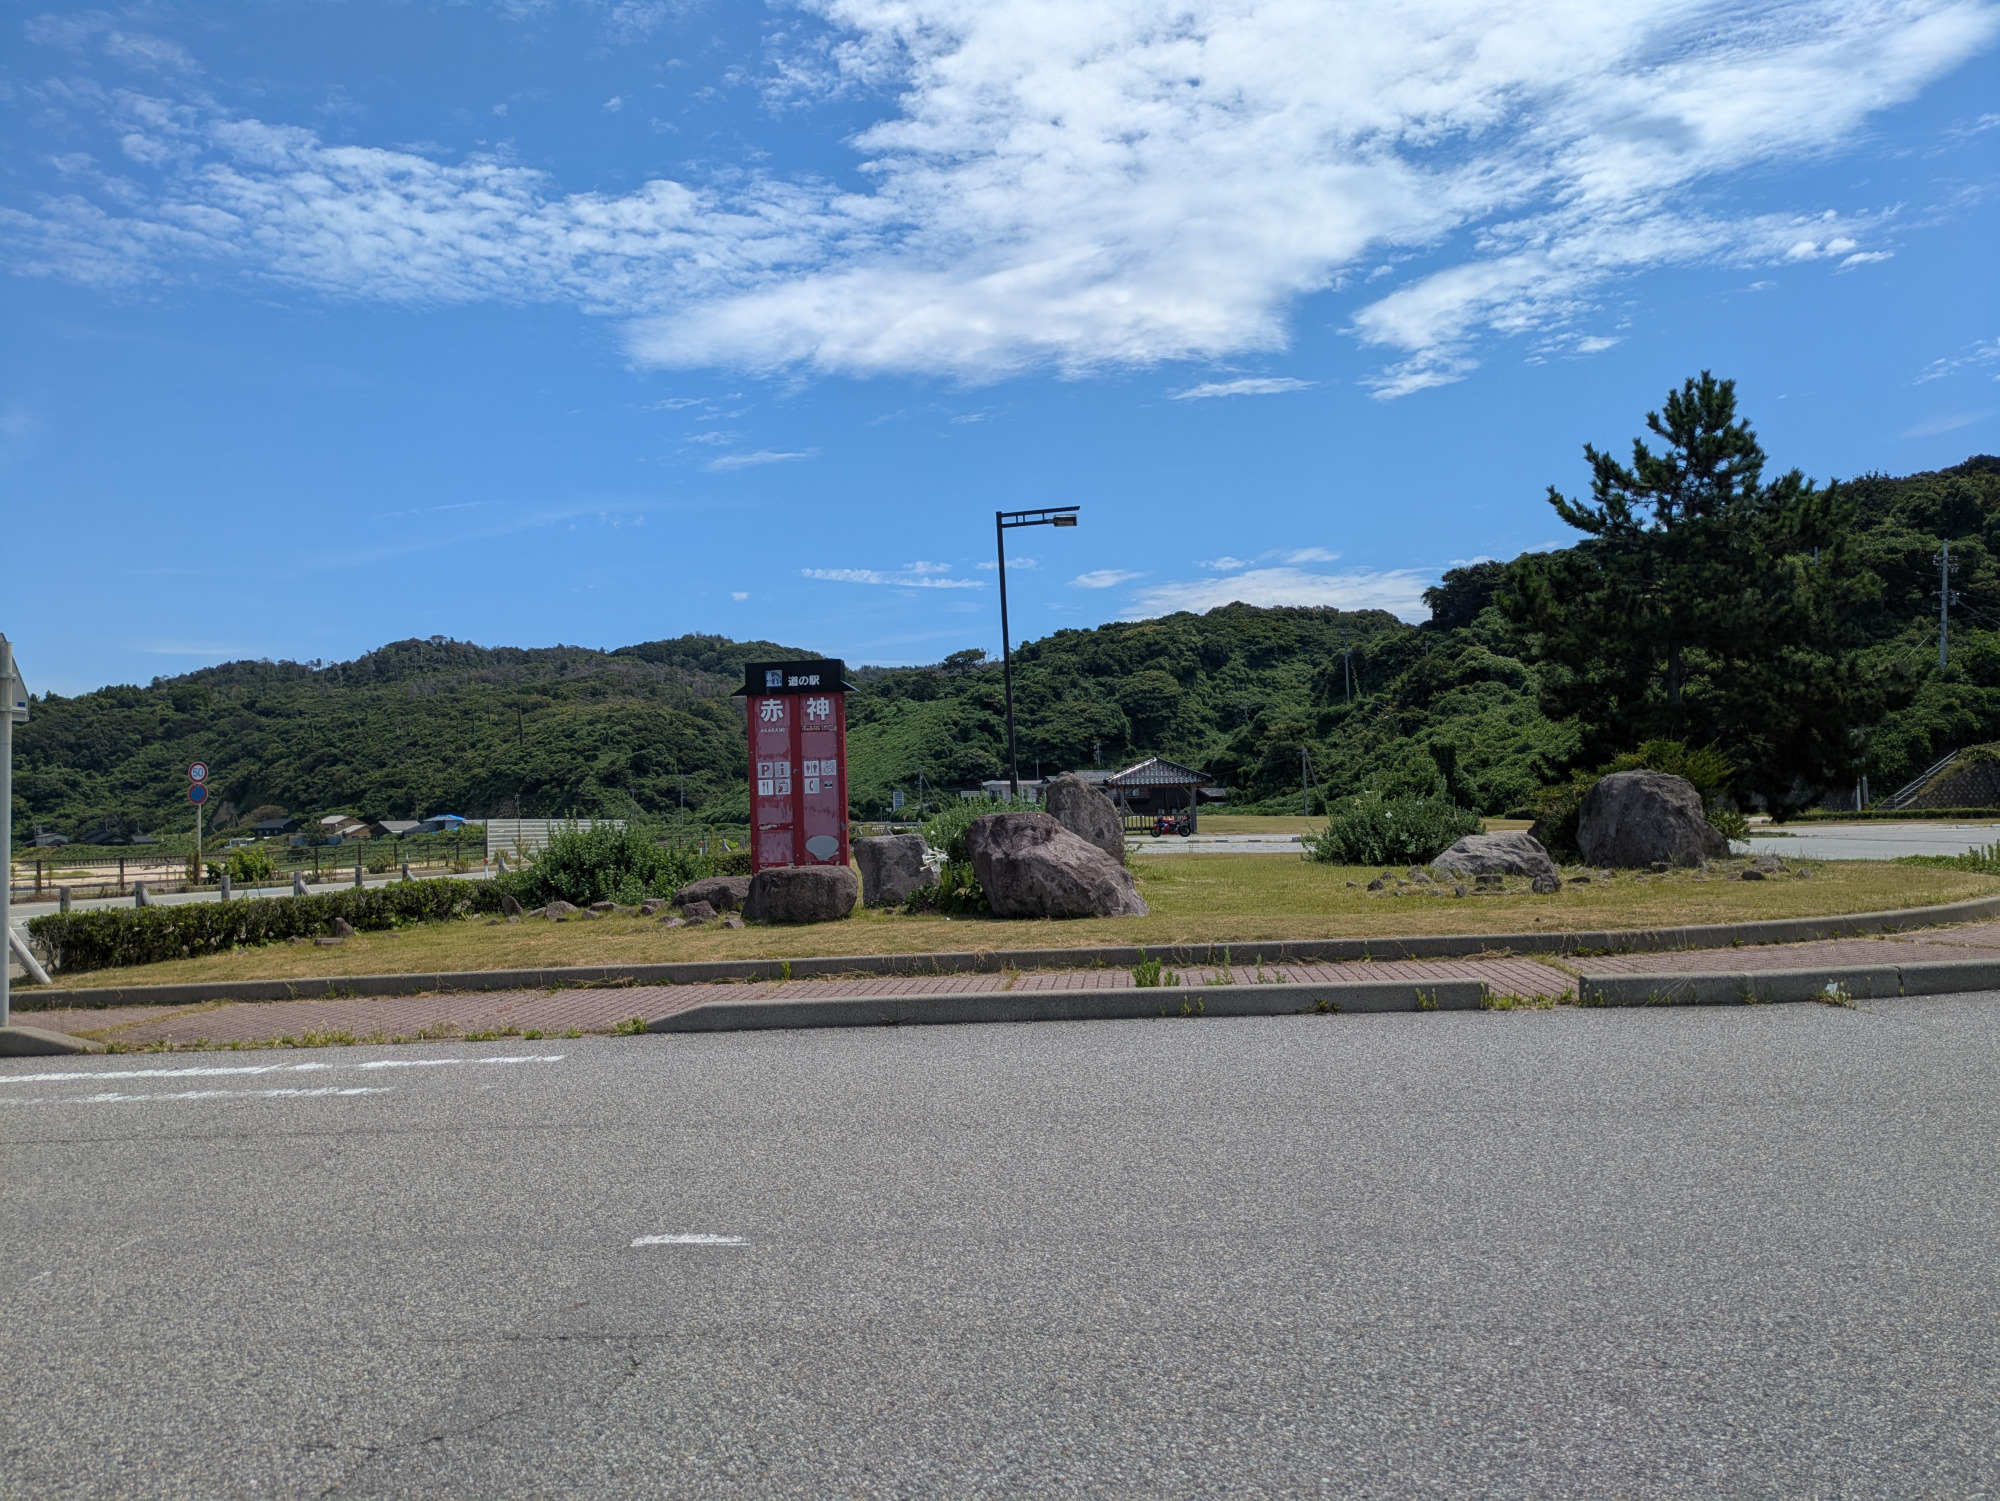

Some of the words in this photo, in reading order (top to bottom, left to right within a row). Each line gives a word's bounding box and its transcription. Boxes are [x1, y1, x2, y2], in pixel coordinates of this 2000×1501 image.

[788, 674, 820, 687] 道の駅
[760, 698, 784, 723] 赤
[806, 696, 830, 721] 神
[192, 767, 204, 778] 50
[761, 764, 770, 776] P
